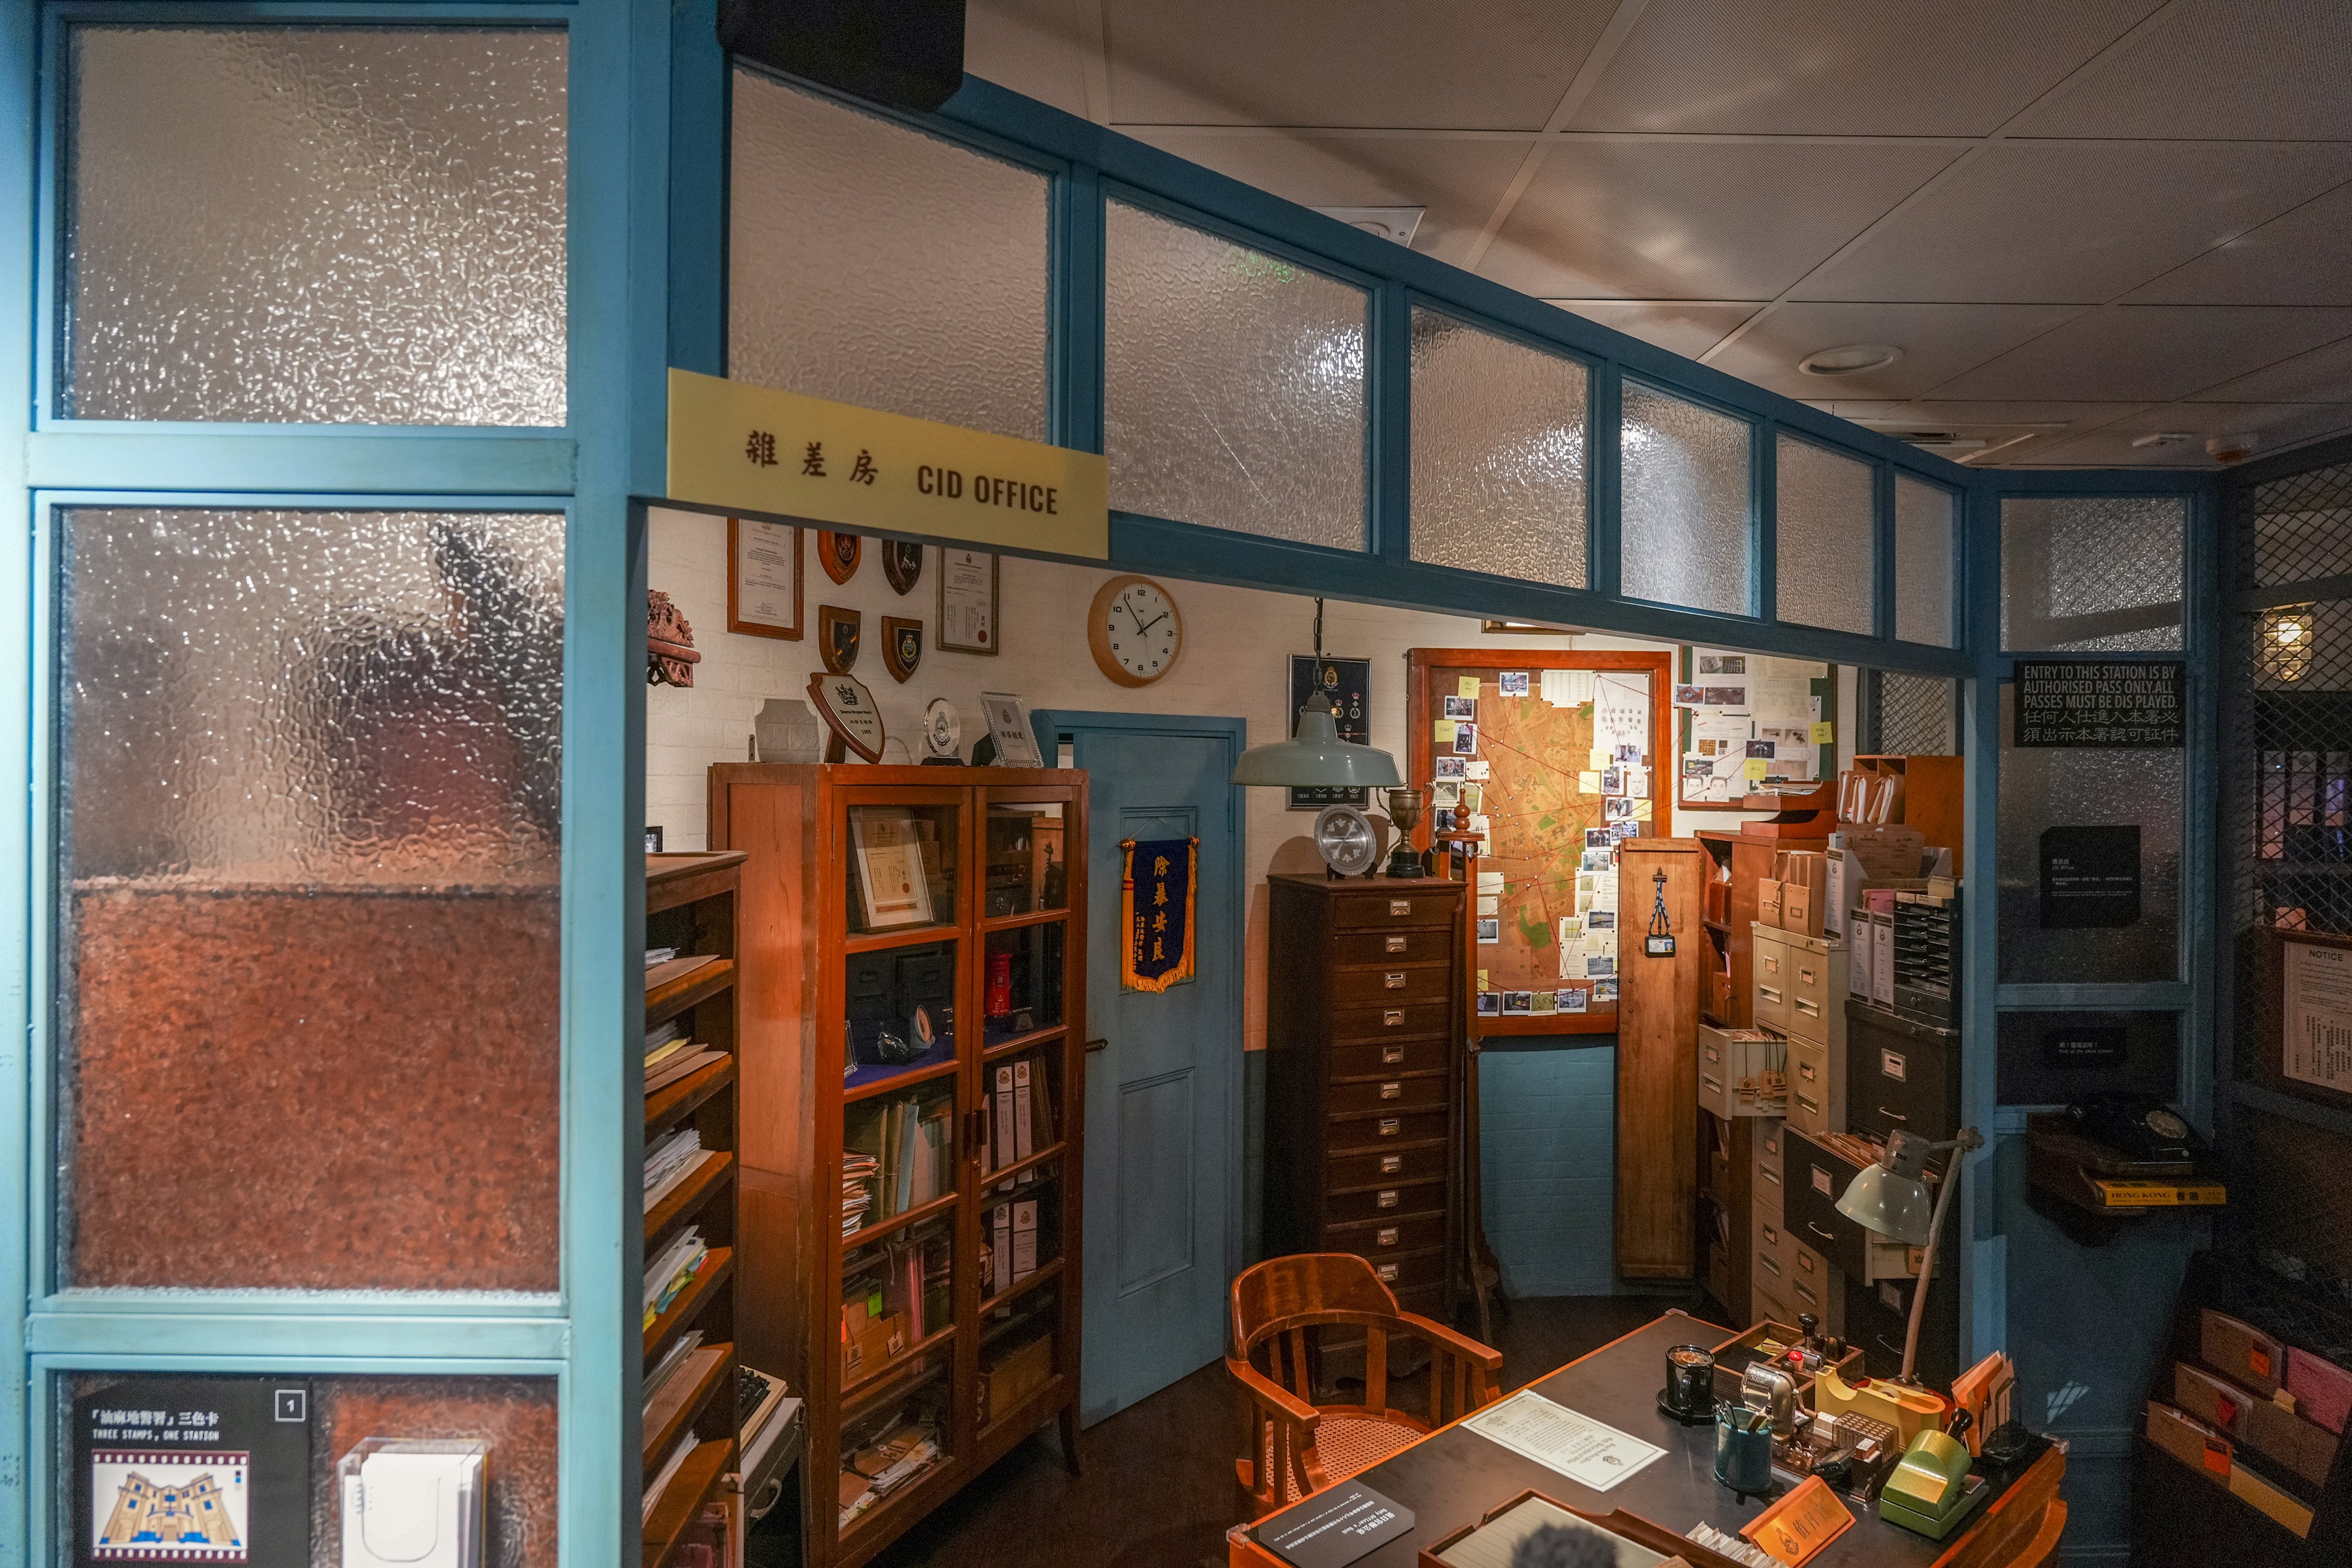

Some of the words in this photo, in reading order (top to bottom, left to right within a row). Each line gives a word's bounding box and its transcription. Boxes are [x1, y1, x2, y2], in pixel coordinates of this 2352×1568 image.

[745, 430, 879, 486] 雜差房
[917, 465, 963, 499] CID
[974, 475, 1058, 515] OFFICE
[2025, 666, 2058, 679] ENTRY
[2060, 666, 2073, 679] TO
[2075, 666, 2099, 679] THIS
[2103, 666, 2146, 679] STATION
[2149, 666, 2160, 679] IS
[2162, 666, 2176, 679] BY
[2024, 681, 2092, 694] AUTHORISED
[2096, 681, 2121, 694] PASS
[2024, 695, 2063, 708] PASSES
[2066, 695, 2096, 708] MUST
[2099, 695, 2112, 708] BE
[2023, 709, 2180, 724] 任何人仕進入本署必
[2023, 727, 2179, 742] 須出示本署認可証件
[1152, 856, 1171, 962] 除暴安良
[2309, 949, 2343, 961] NOTICE
[287, 1400, 295, 1413] 1
[93, 1429, 118, 1440] THREE
[164, 1430, 179, 1440] ONE
[183, 1431, 219, 1441] STATION
